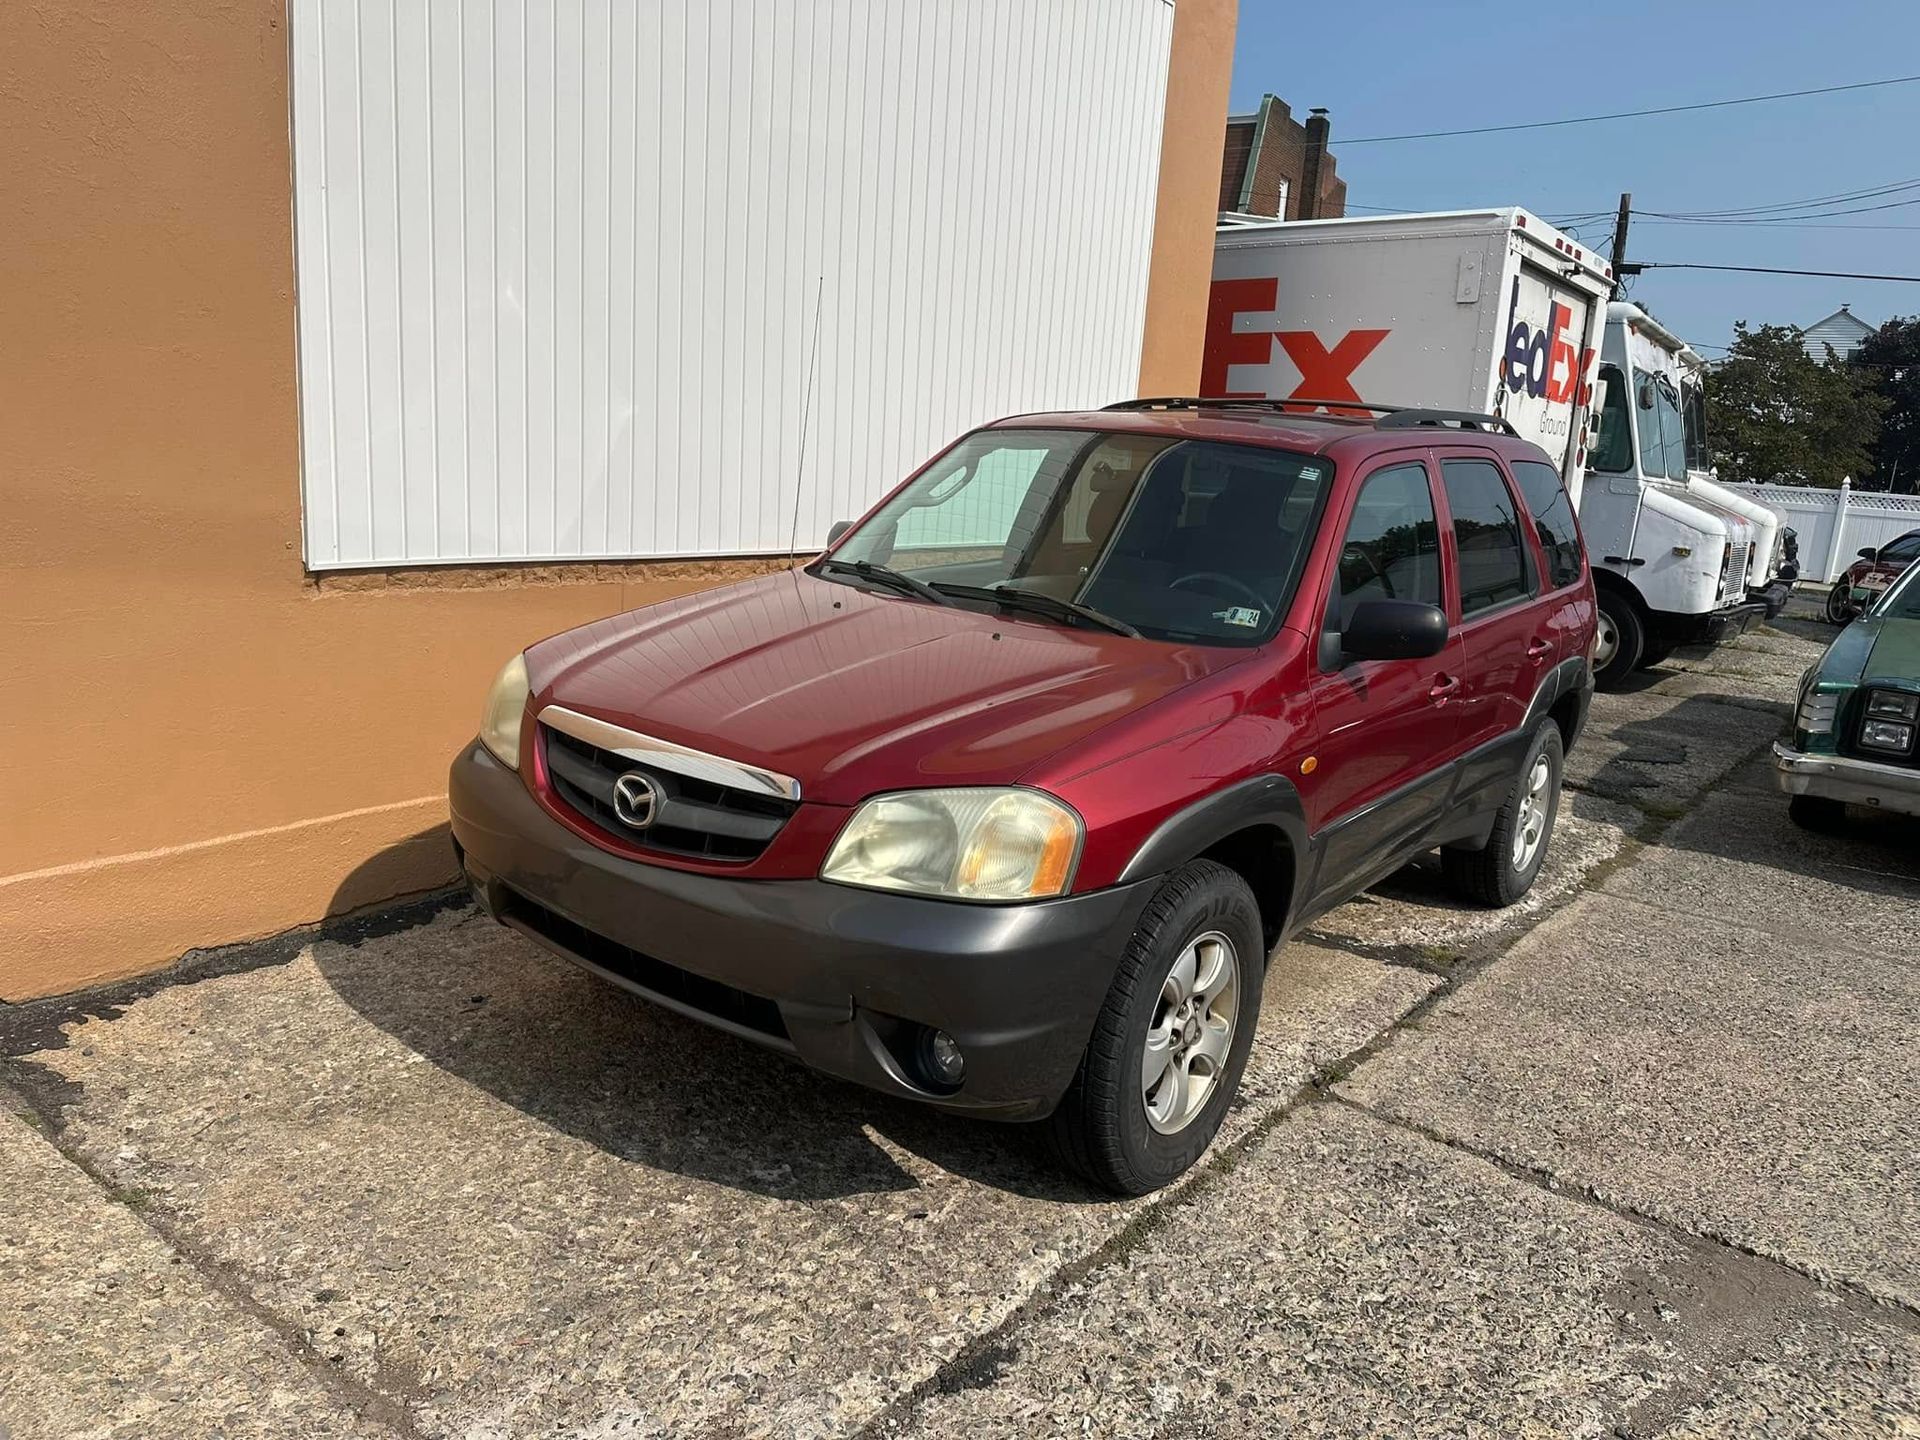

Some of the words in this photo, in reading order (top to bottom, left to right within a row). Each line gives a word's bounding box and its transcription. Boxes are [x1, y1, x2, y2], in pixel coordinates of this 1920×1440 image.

[1505, 275, 1596, 406] edEx
[1540, 411, 1567, 437] Ground
[1230, 608, 1239, 620] 8
[1248, 611, 1259, 624] 24
